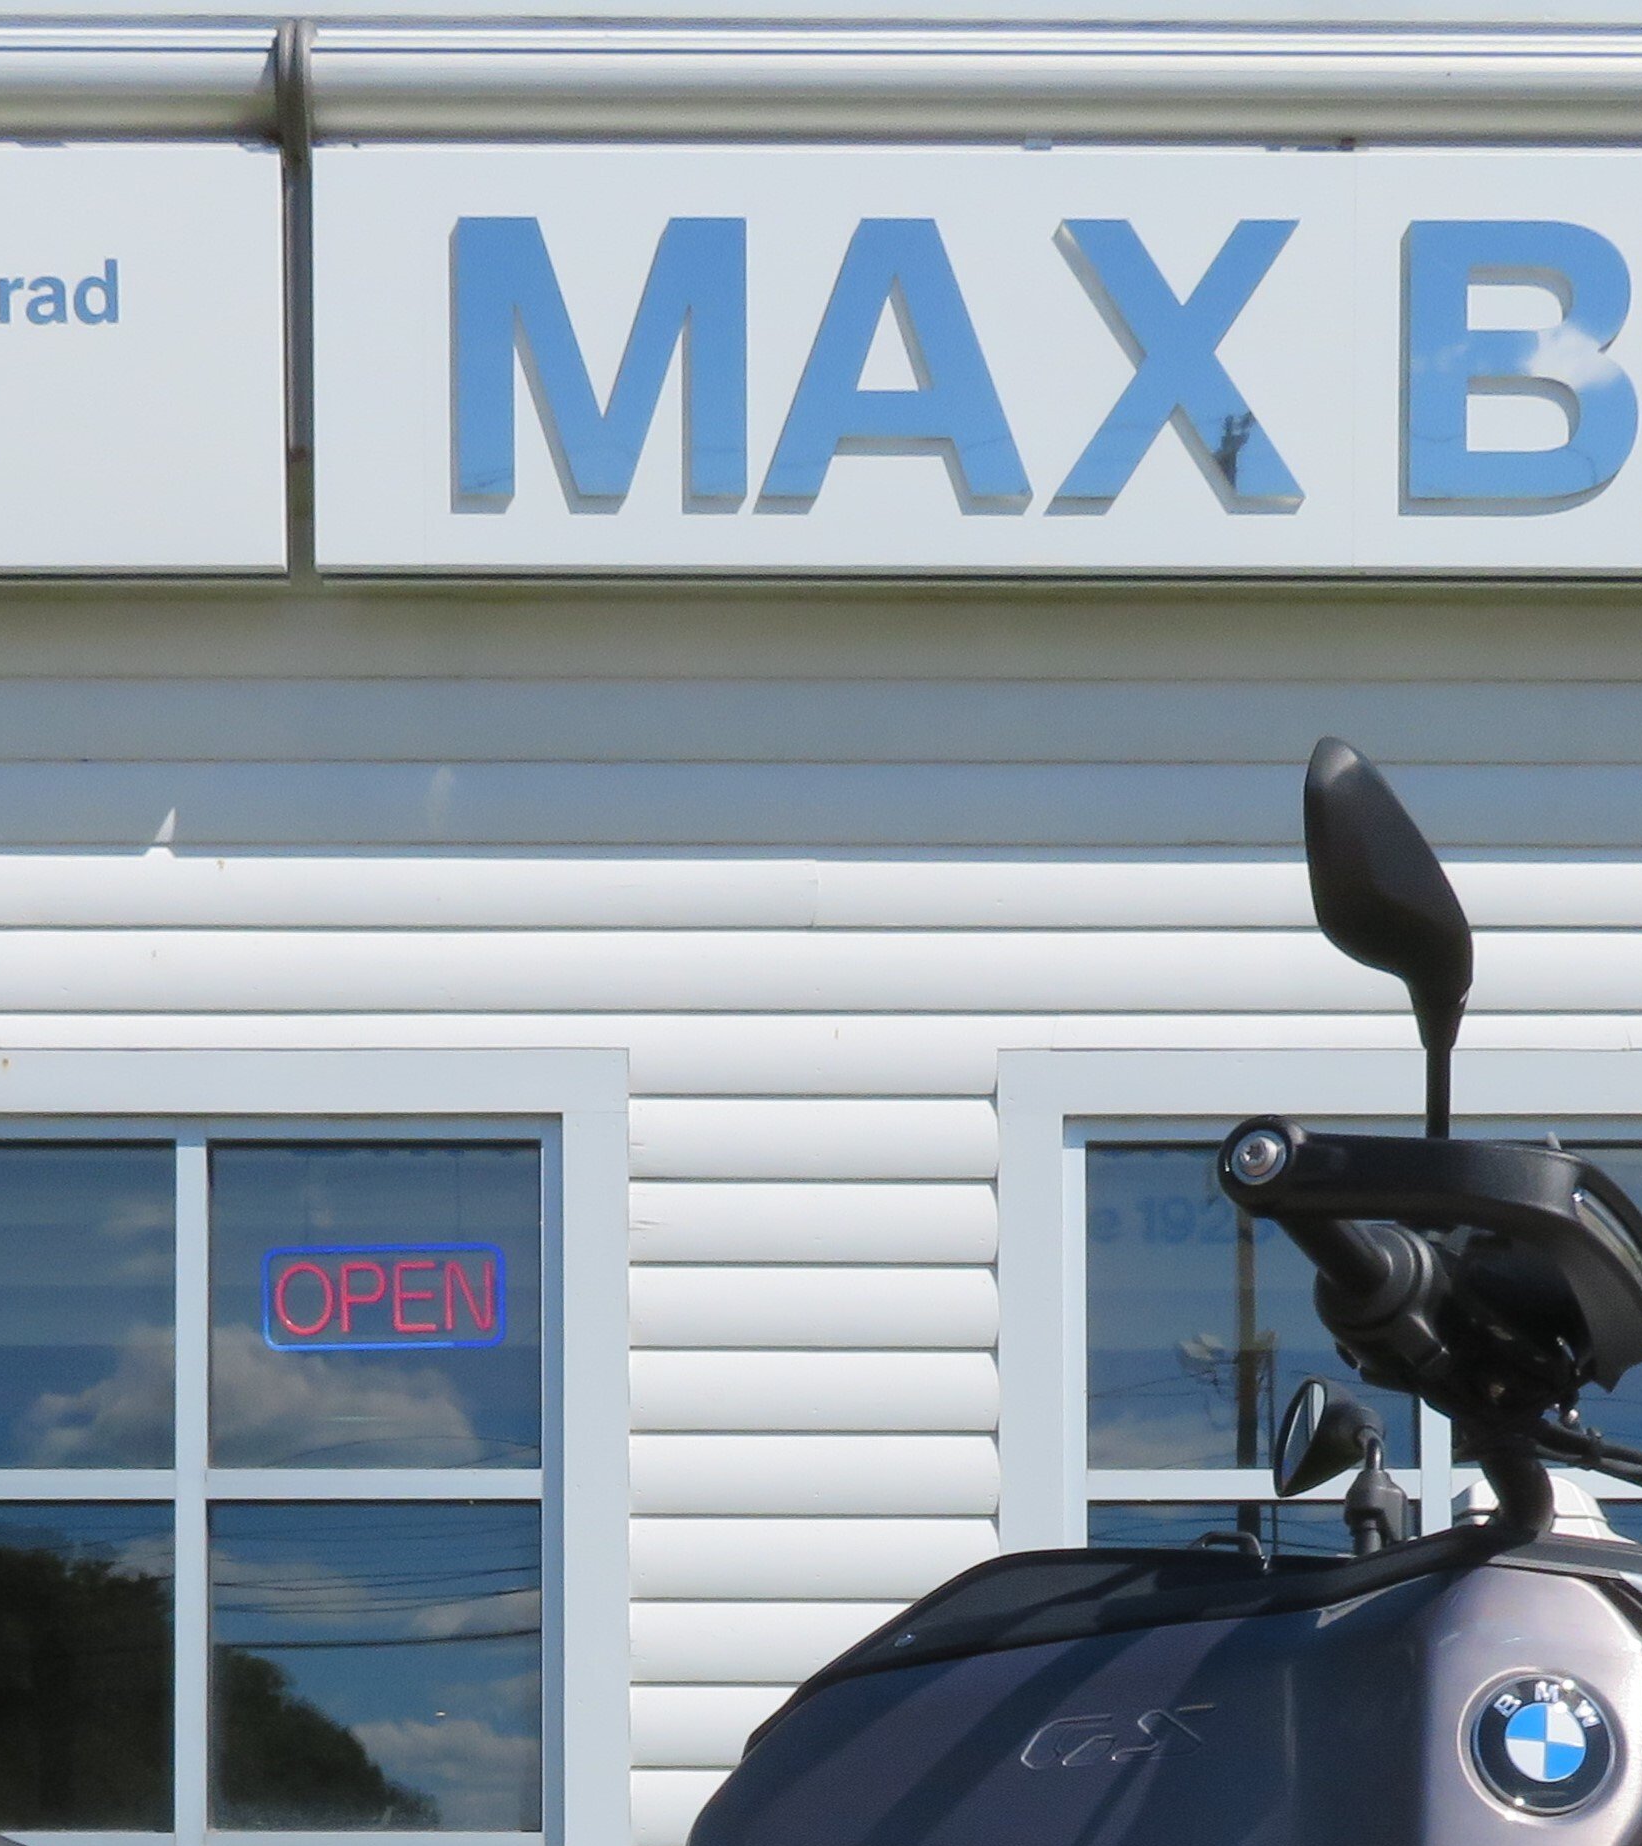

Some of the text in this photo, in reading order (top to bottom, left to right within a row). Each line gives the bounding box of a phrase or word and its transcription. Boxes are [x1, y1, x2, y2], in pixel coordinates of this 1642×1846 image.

[450, 216, 1305, 515] MAX
[1139, 1195, 1270, 1245] 192
[274, 1260, 494, 1336] OPEN
[1021, 1702, 1217, 1770] GS
[1493, 1680, 1601, 1728] BMW
